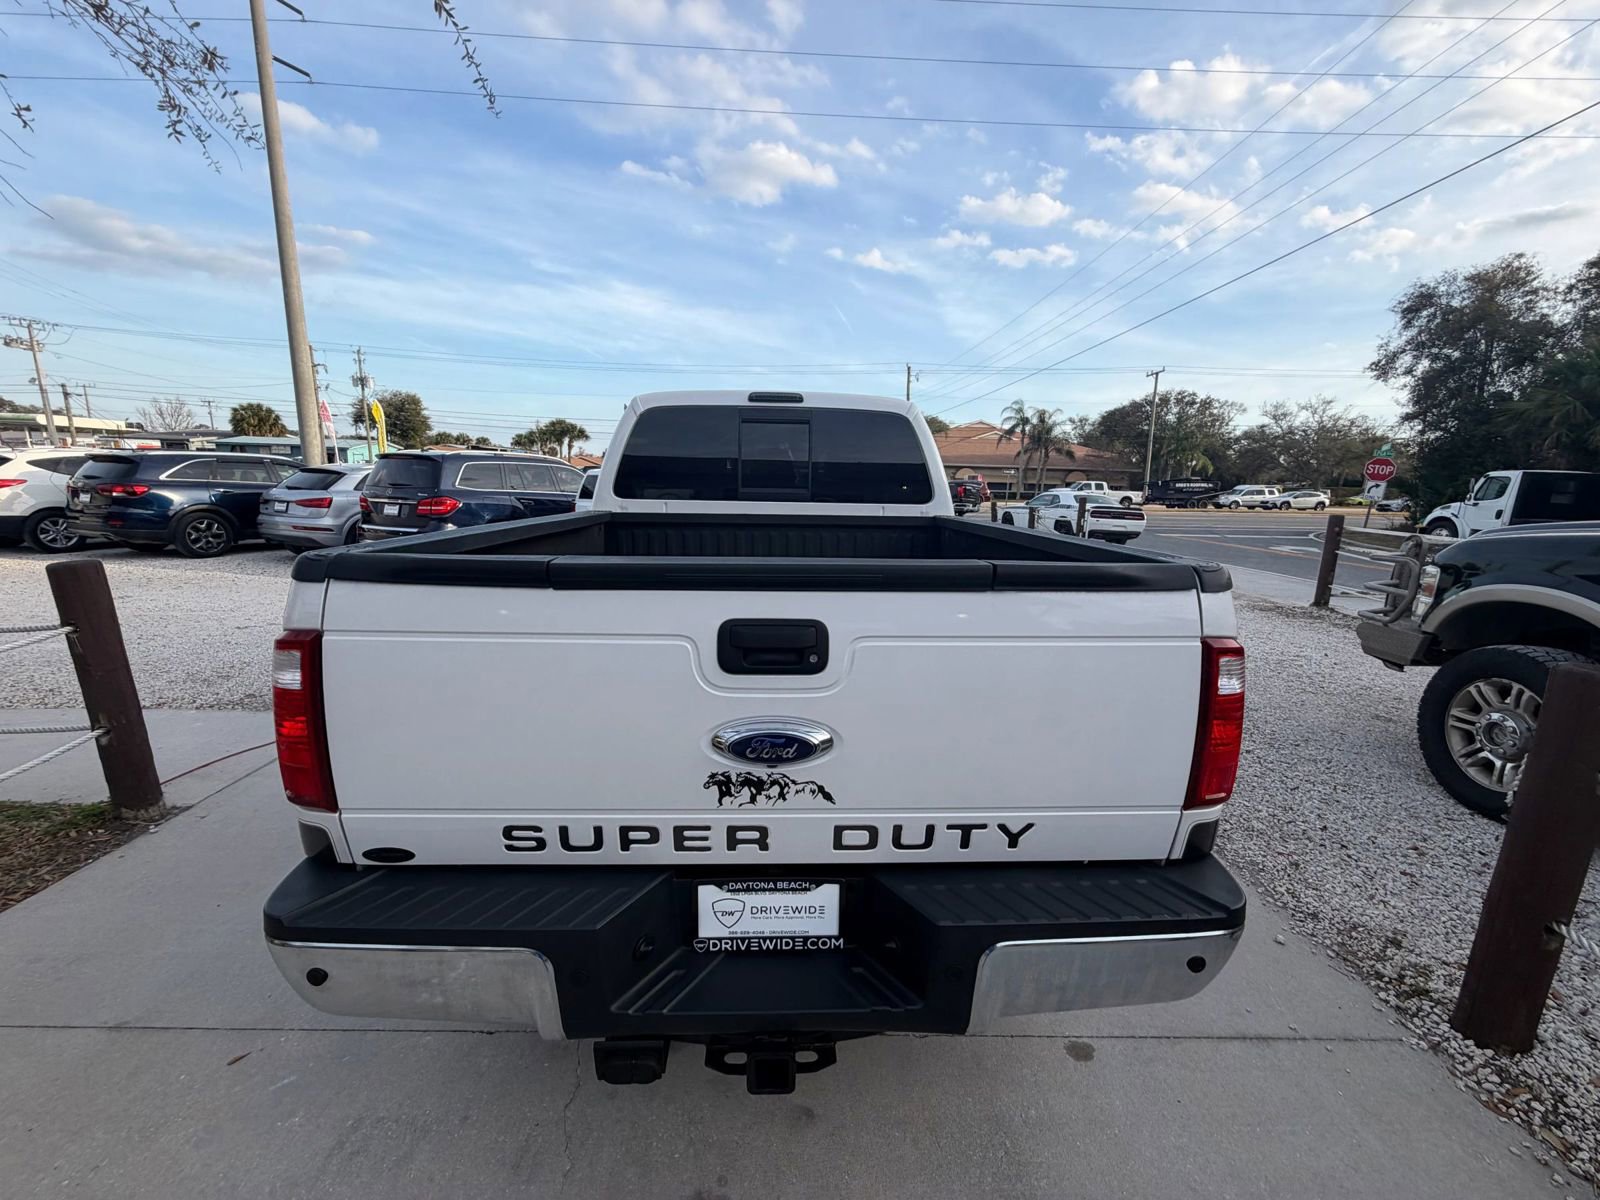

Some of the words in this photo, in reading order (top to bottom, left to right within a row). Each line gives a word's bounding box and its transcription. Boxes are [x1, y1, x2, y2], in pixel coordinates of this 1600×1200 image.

[1366, 464, 1394, 475] STOP
[745, 737, 799, 759] Ford
[501, 824, 770, 853] SUPER
[832, 822, 1036, 852] DUTY
[728, 881, 775, 890] DAYTONA
[776, 881, 809, 889] BEACH
[750, 905, 826, 915] DRIVEWIDE
[709, 937, 844, 951] DRIVEWIDE.COM
